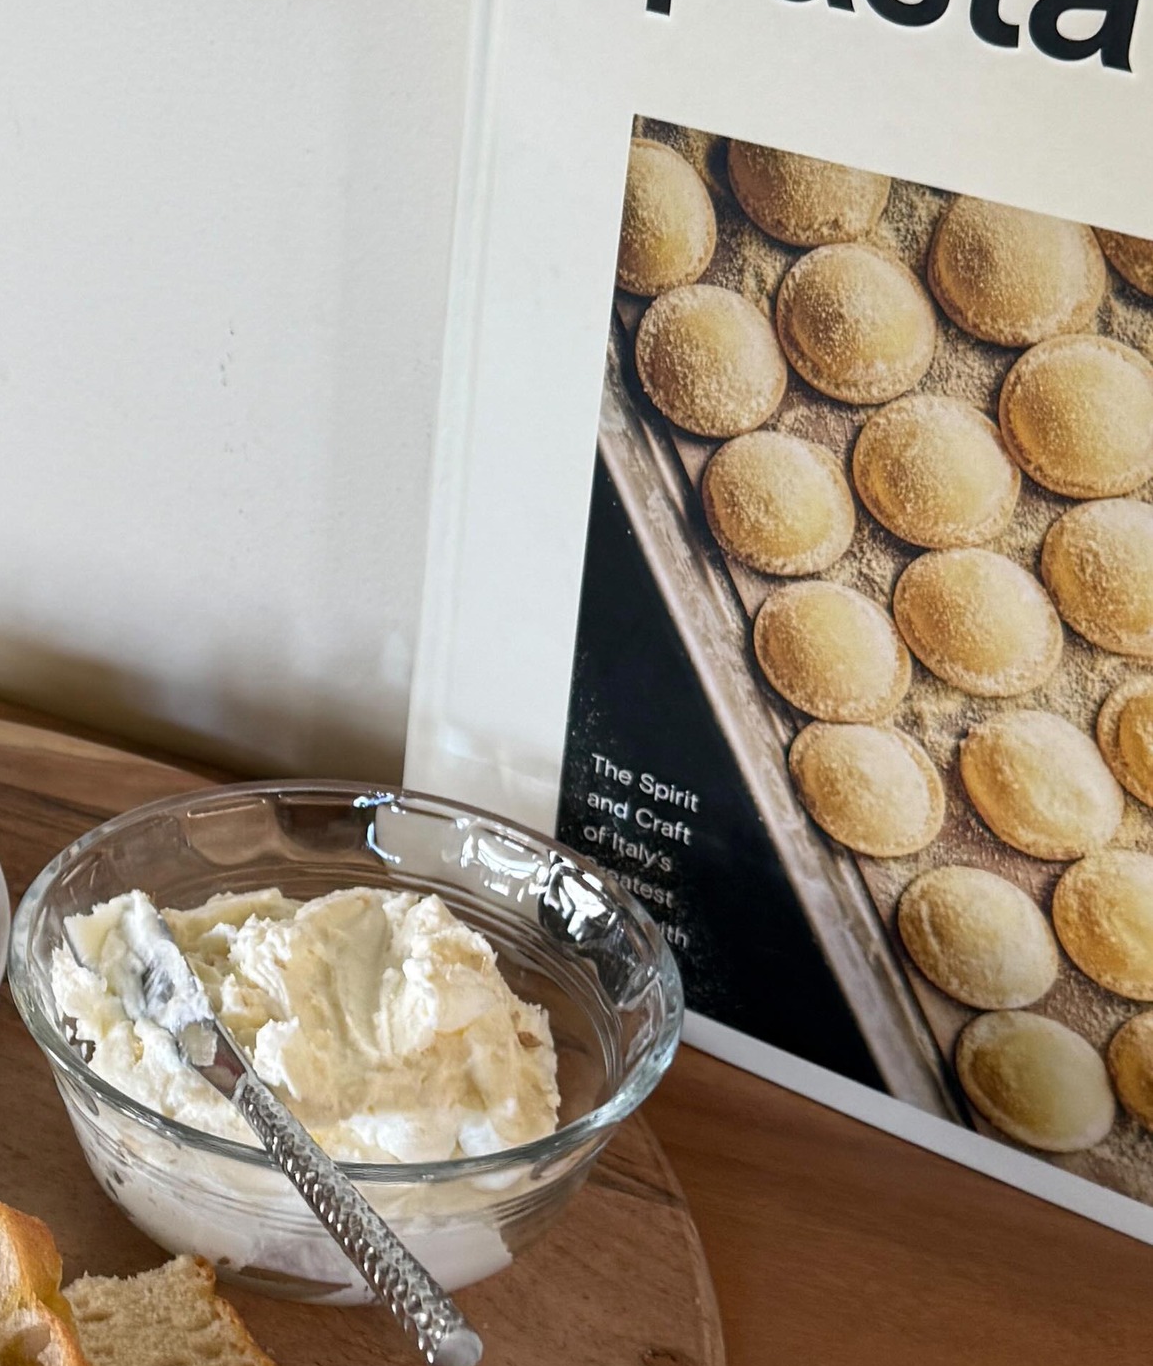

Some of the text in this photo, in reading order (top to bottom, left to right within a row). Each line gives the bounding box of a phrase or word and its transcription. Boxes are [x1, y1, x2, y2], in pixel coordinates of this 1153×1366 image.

[591, 752, 700, 813] The Spirit
[587, 790, 692, 846] and Craft
[583, 824, 672, 873] of Italy's
[585, 855, 674, 909] atest
[659, 919, 689, 948] ith
